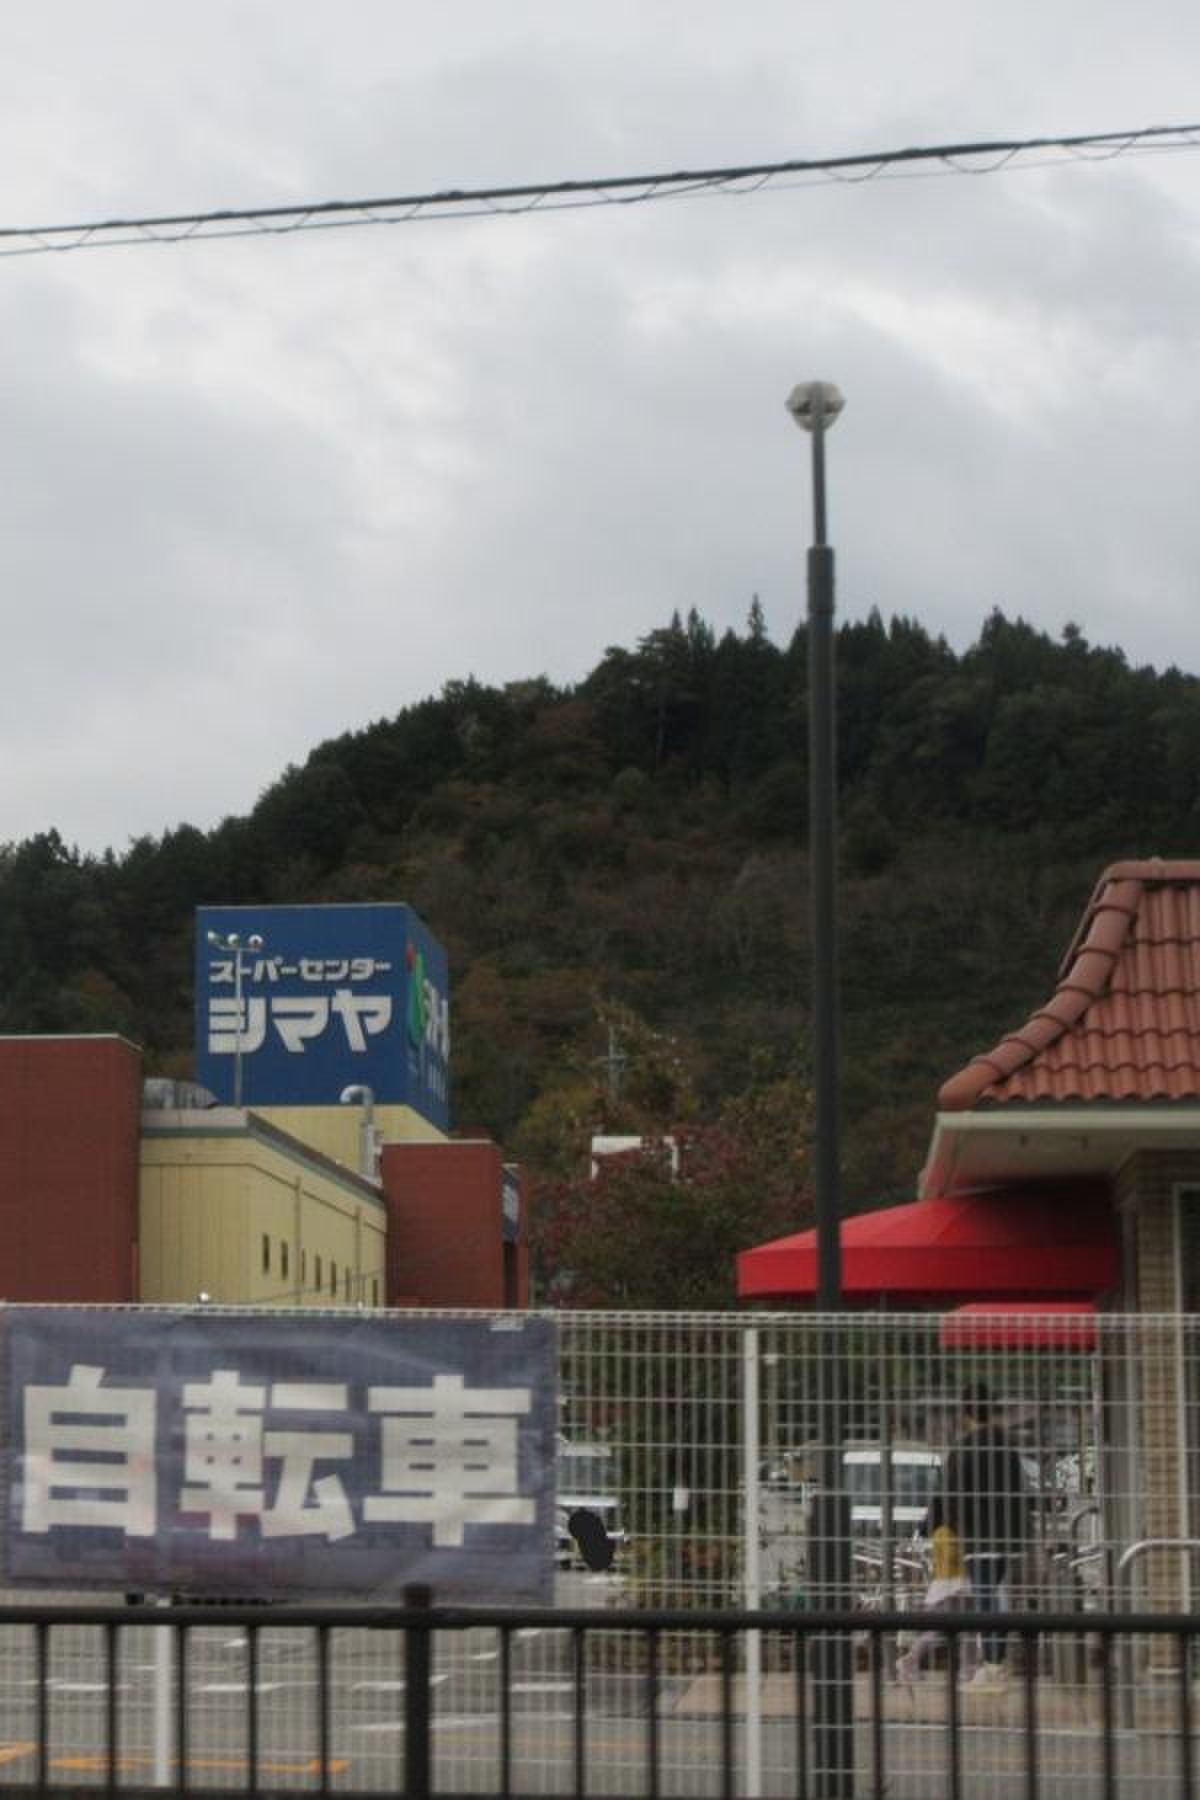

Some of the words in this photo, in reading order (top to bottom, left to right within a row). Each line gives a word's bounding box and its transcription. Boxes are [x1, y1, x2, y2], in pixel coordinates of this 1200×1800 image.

[208, 955, 393, 983] スーパーセンター
[207, 988, 393, 1053] シマヤ
[22, 1364, 536, 1547] 自転車
